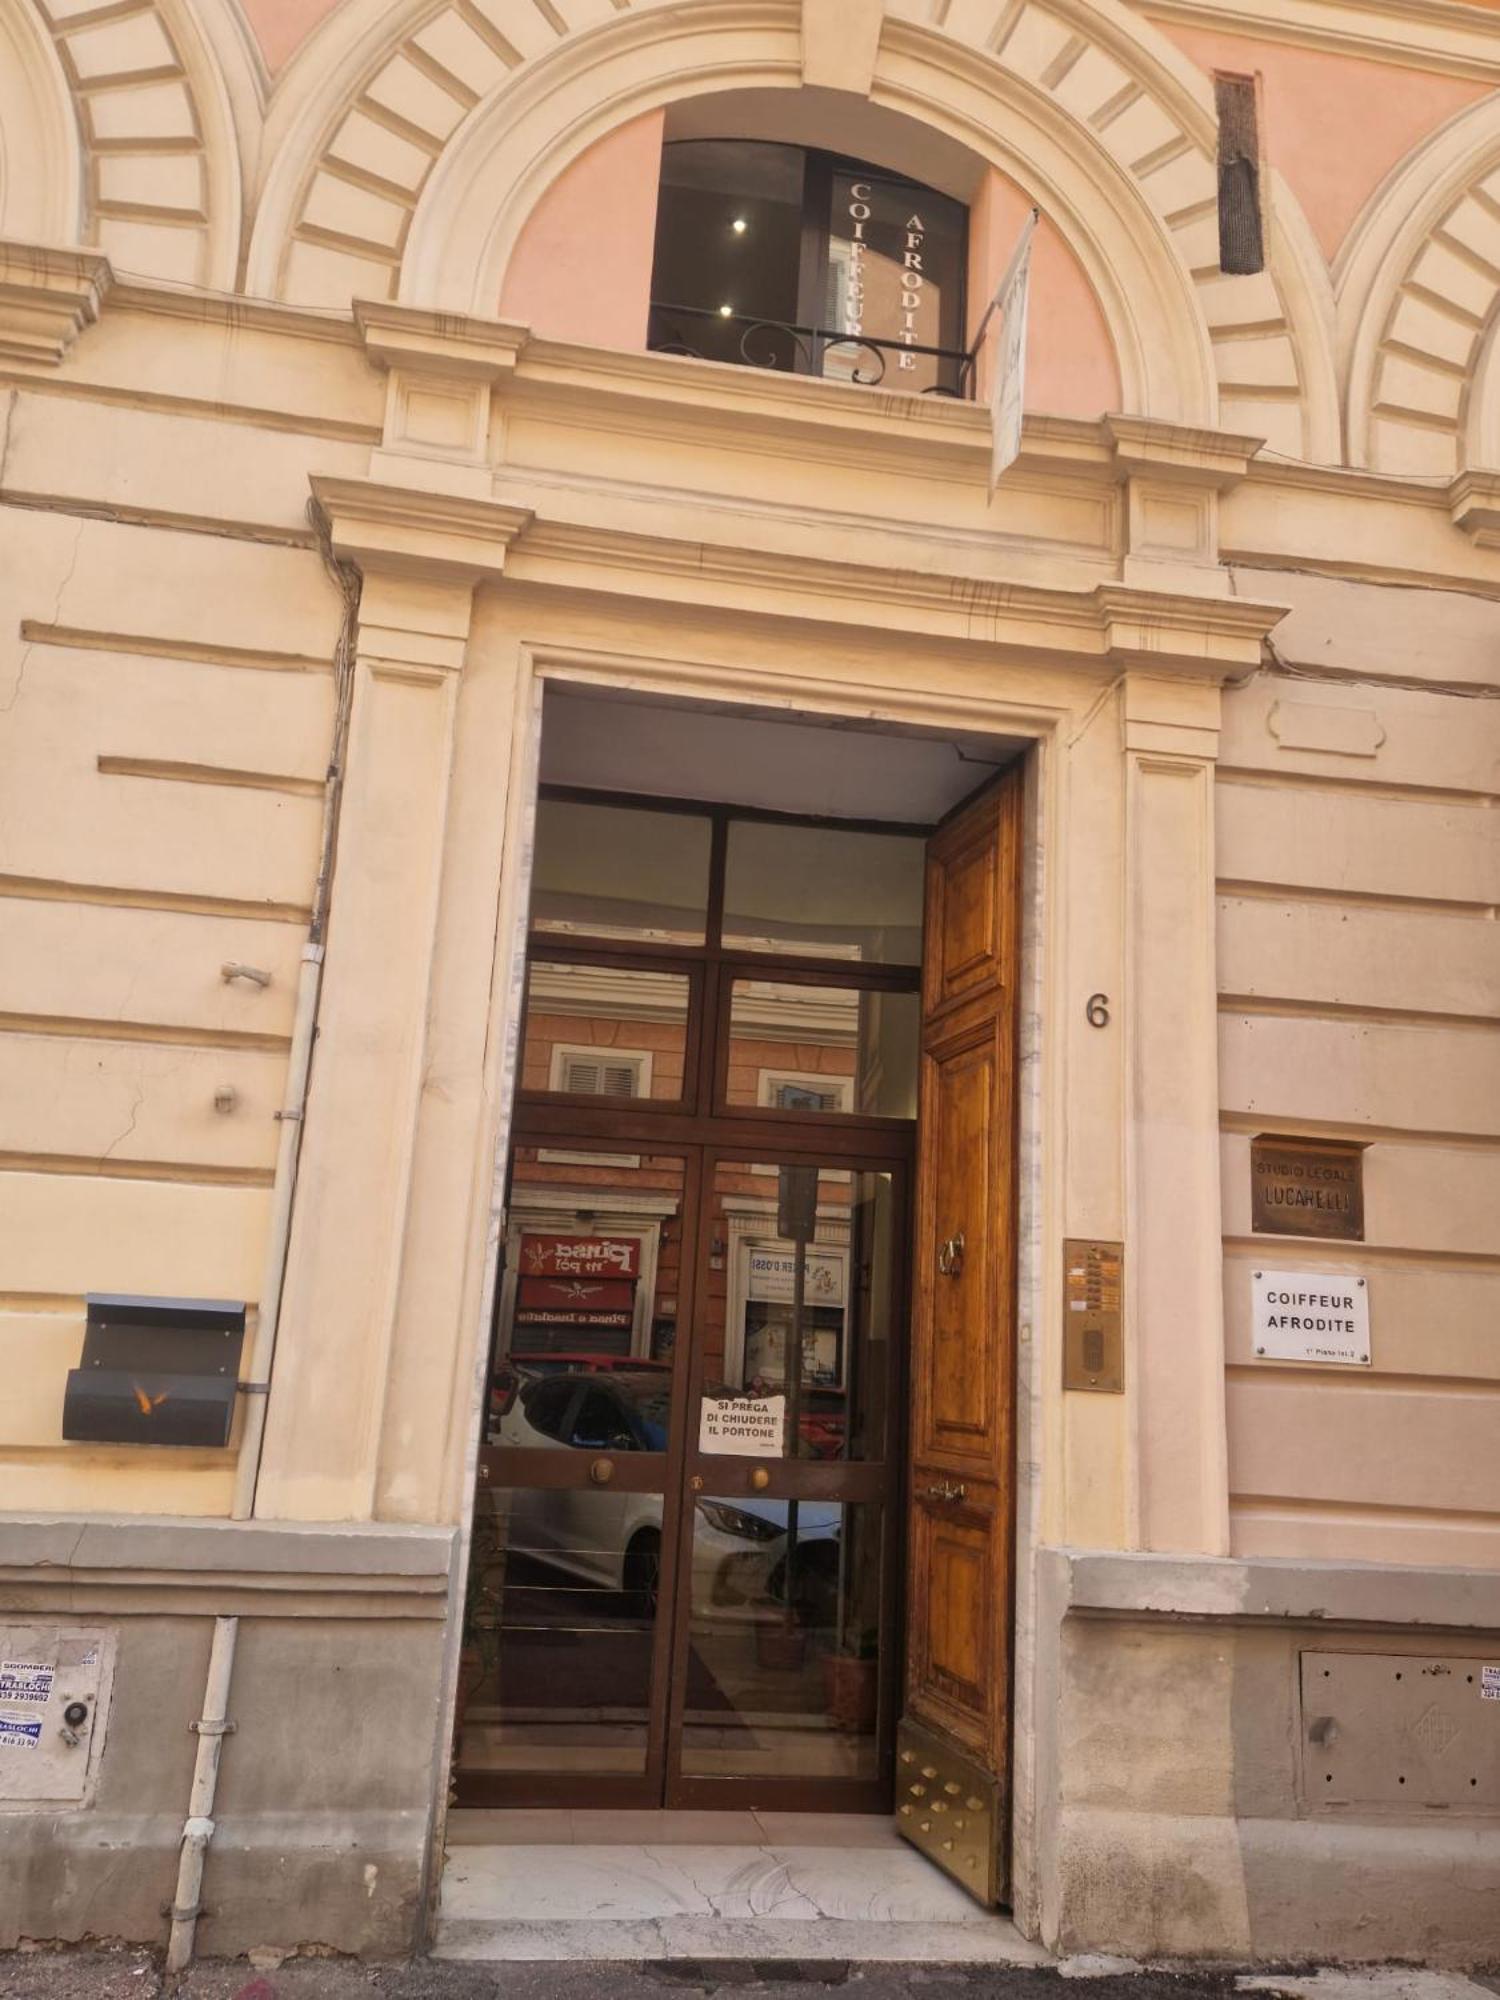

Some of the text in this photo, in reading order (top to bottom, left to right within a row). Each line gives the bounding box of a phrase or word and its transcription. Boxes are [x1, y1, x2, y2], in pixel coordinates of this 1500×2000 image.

[845, 183, 872, 345] COIFFEUR
[899, 214, 925, 370] AFRODITE
[1086, 992, 1110, 1029] 6
[1256, 1162, 1355, 1184] STUDIO LEGALE
[1265, 1186, 1349, 1211] LUCARELLI
[1267, 1291, 1353, 1310] COIFFEUR
[1267, 1315, 1355, 1333] AFRODITE
[718, 1402, 769, 1412] SI PREGA
[707, 1413, 778, 1426] DI CHIUDERE
[708, 1426, 775, 1438] IL PORTONE
